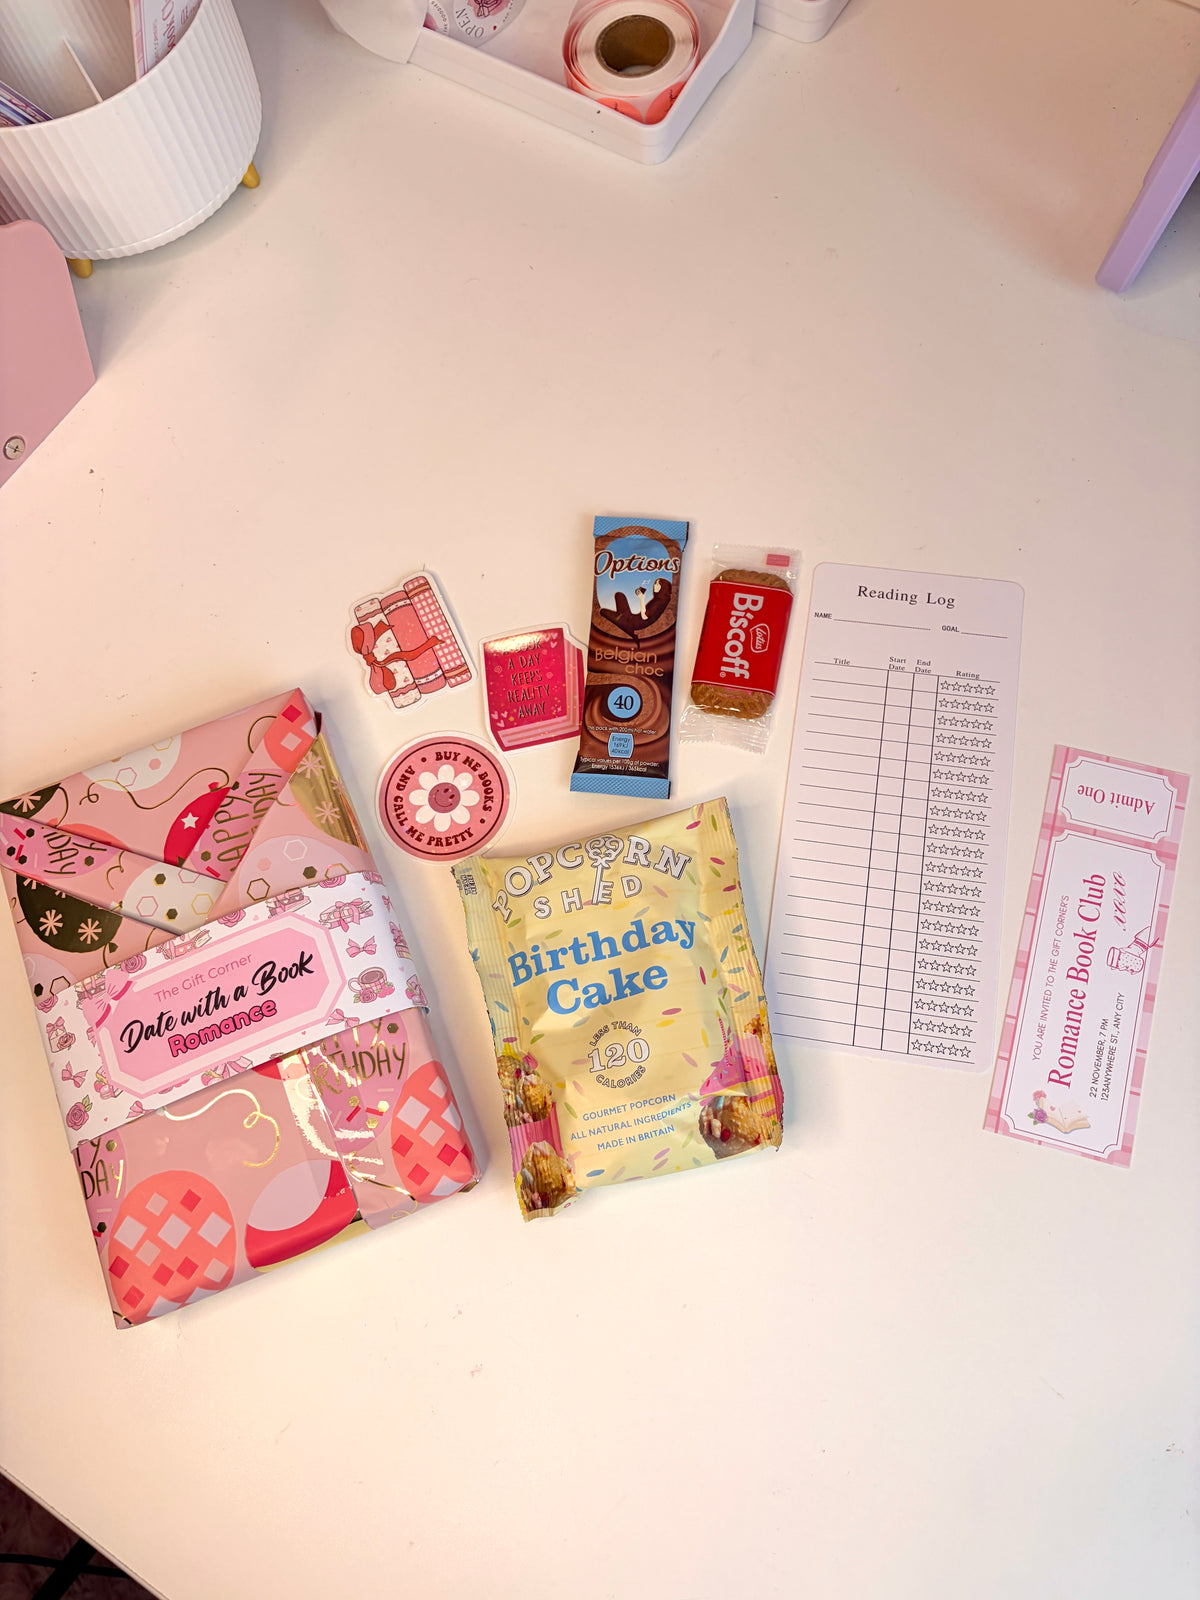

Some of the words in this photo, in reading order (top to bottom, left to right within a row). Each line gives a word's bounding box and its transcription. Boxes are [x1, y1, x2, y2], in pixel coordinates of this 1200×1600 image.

[455, 8, 485, 38] OPEN
[594, 550, 680, 580] Options
[857, 585, 918, 605] Reading
[926, 592, 955, 609] Log
[814, 612, 833, 620] NAME
[720, 592, 764, 680] Biscoff
[941, 625, 960, 633] GOAL
[508, 658, 515, 670] A
[520, 652, 540, 668] DAY
[595, 646, 657, 664] Belgian
[889, 656, 906, 664] Start
[916, 659, 931, 667] End
[511, 670, 543, 687] KEEPS
[625, 662, 664, 677] choc
[914, 666, 931, 674] Date
[955, 670, 980, 680] Rating
[507, 683, 550, 703] REALITY
[613, 695, 634, 711] 40
[518, 701, 545, 719] AWAY
[395, 765, 416, 792] AND
[591, 763, 608, 771] Energy
[435, 751, 461, 762] BUY
[462, 756, 482, 772] ME
[478, 771, 494, 812] BOOKS
[1077, 784, 1106, 804] One
[1110, 792, 1156, 815] Admit
[393, 795, 408, 827] CALL
[212, 795, 253, 872] APPY
[405, 825, 426, 842] ME
[426, 827, 474, 847] PRETTY
[491, 834, 692, 924] POPCORN
[533, 873, 643, 919] SHED
[1077, 873, 1107, 923] Club
[1055, 895, 1070, 937] CORNER'S
[507, 918, 696, 988] Birthday
[1051, 938, 1062, 957] GIFT
[1066, 926, 1098, 985] Book
[1048, 958, 1059, 974] THE
[154, 986, 180, 1003] The
[181, 973, 206, 991] Gift
[207, 953, 253, 979] Corner
[1045, 975, 1054, 988] TO
[546, 965, 669, 1015] Cake
[1115, 992, 1125, 1011] CITY
[119, 1009, 178, 1054] Date
[180, 986, 231, 1027] with
[233, 983, 248, 999] a
[251, 950, 315, 996] Book
[1040, 989, 1053, 1022] INVITED
[167, 999, 278, 1058] Romance
[1036, 1022, 1047, 1041] ARE
[1100, 1018, 1109, 1031] PM
[1112, 1011, 1122, 1030] ANY
[589, 1025, 609, 1047] LESS
[611, 1020, 642, 1037] THAN
[1047, 988, 1087, 1089] Romance
[587, 1037, 650, 1073] 120
[1032, 1040, 1043, 1061] YOU
[1091, 1038, 1107, 1086] NOVEMBER,
[595, 1065, 646, 1088] CALORIES
[1101, 1045, 1117, 1101] 123ANYWHERE
[1089, 1086, 1098, 1098] 22
[582, 1104, 627, 1121] GOURMET
[629, 1093, 676, 1111] POPCORN
[570, 1130, 587, 1141] ALL
[588, 1120, 632, 1137] NATURAL
[633, 1101, 692, 1126] INGREDIENTS
[597, 1138, 624, 1151] MADE
[625, 1135, 636, 1145] IN
[638, 1124, 675, 1141] BRITAIN
[80, 1158, 124, 1200] DAY
